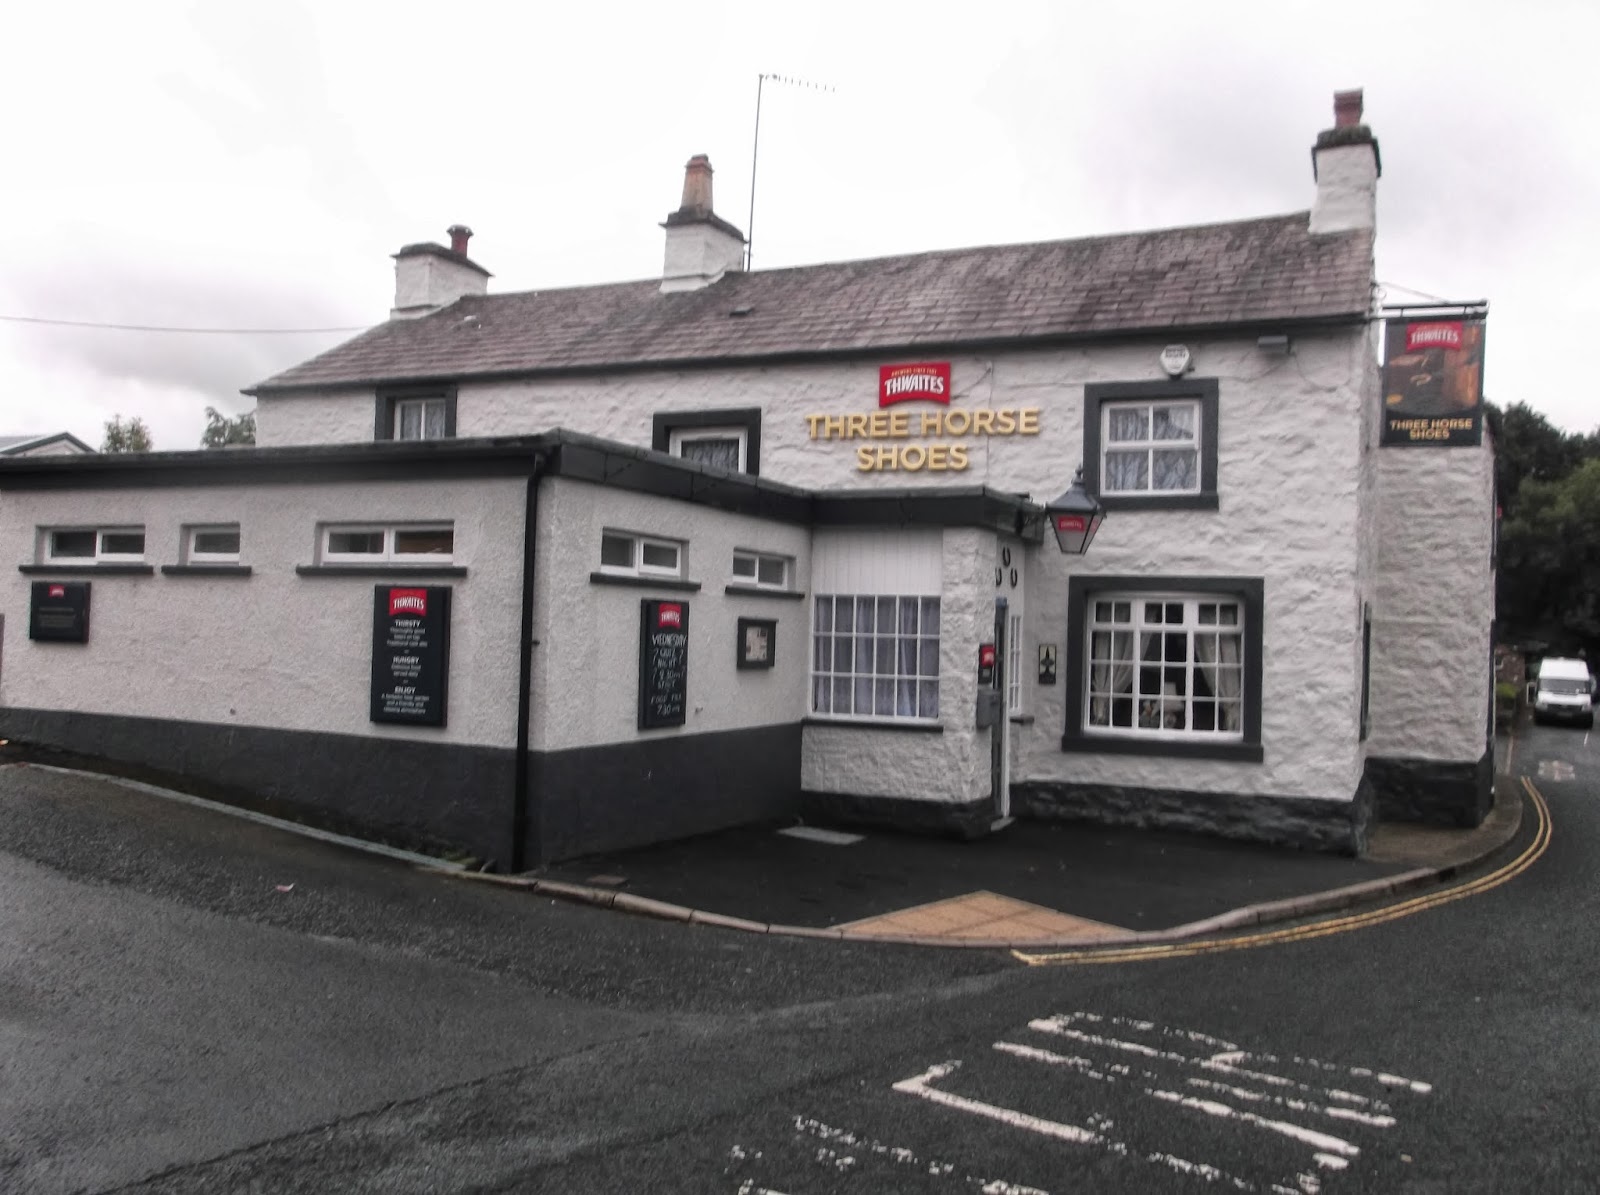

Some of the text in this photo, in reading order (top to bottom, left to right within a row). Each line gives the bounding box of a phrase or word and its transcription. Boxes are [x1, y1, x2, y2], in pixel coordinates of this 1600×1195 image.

[884, 373, 944, 397] THWAITES
[805, 407, 1041, 439] THREE HORSE
[1390, 418, 1472, 431] THREE HORSE
[1410, 429, 1449, 440] SHOES
[857, 443, 969, 472] SHOES
[394, 686, 416, 694] ENJOY
